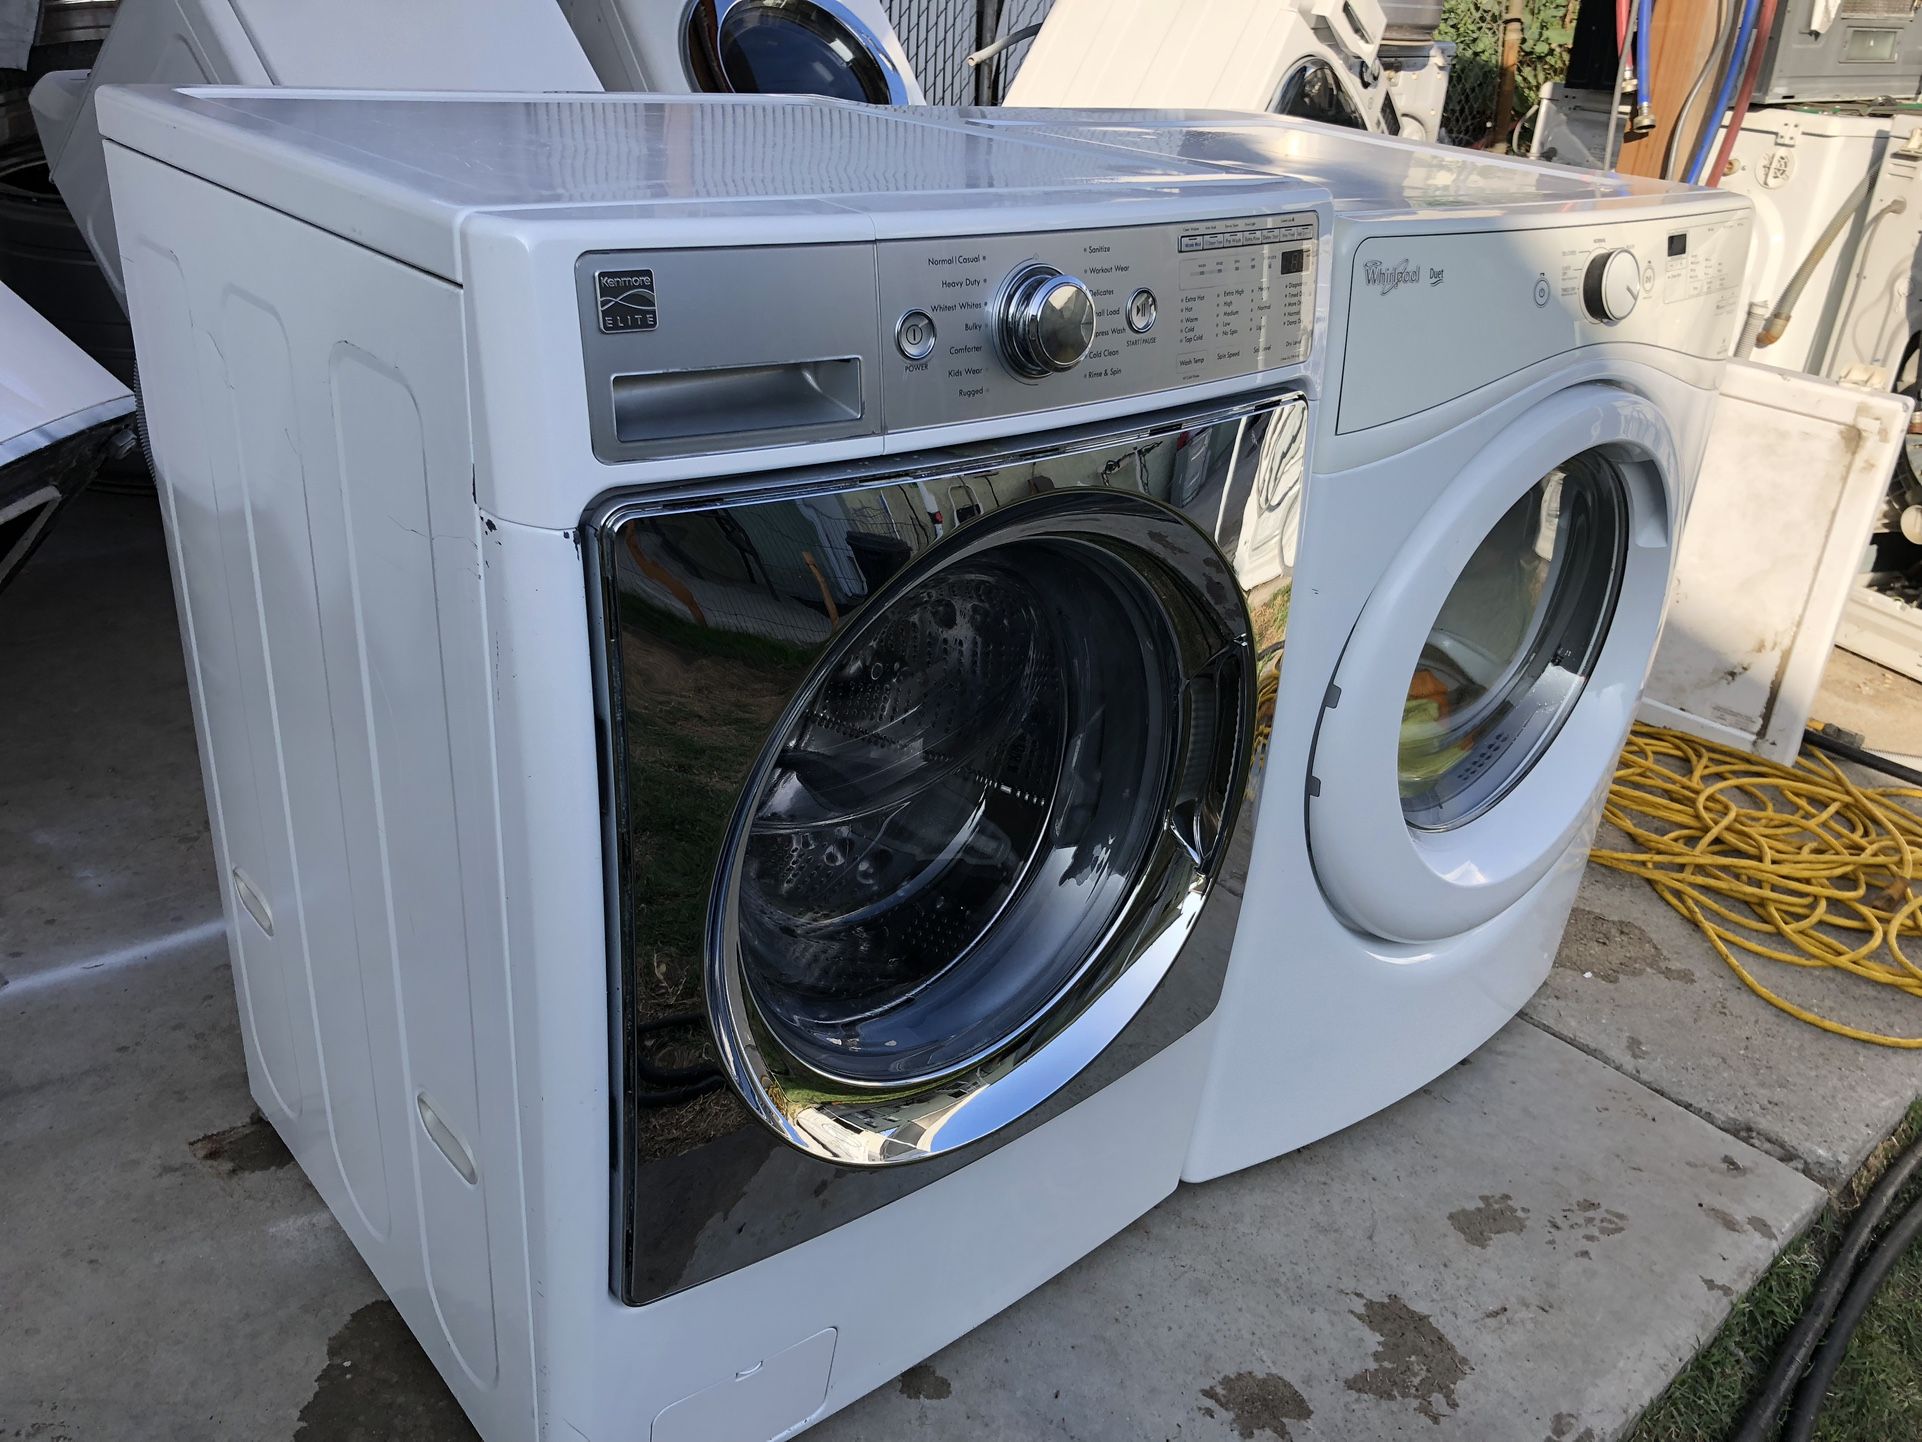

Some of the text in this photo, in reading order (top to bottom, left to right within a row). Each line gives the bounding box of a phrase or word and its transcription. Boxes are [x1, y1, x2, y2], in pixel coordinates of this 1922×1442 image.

[1088, 245, 1111, 254] Sanitize
[1088, 264, 1130, 275] Workout Wear
[1364, 260, 1420, 291] Whirlpool
[1429, 267, 1444, 280] Duet
[600, 276, 651, 288] Kenmore
[941, 277, 981, 289] Heavy Duty
[931, 301, 982, 313] Whitest Whites
[1106, 307, 1120, 317] Load
[605, 314, 654, 327] ELITE
[964, 323, 983, 332] Bulky
[1095, 326, 1127, 339] press Wash
[1184, 326, 1195, 334] Cold
[949, 344, 983, 356] Comforter
[1088, 348, 1119, 360] Cold Clean
[904, 363, 929, 373] POWER
[948, 366, 983, 378] Kids Wear
[1088, 368, 1122, 379] Rinse & Spin
[959, 387, 984, 398] Rugged
